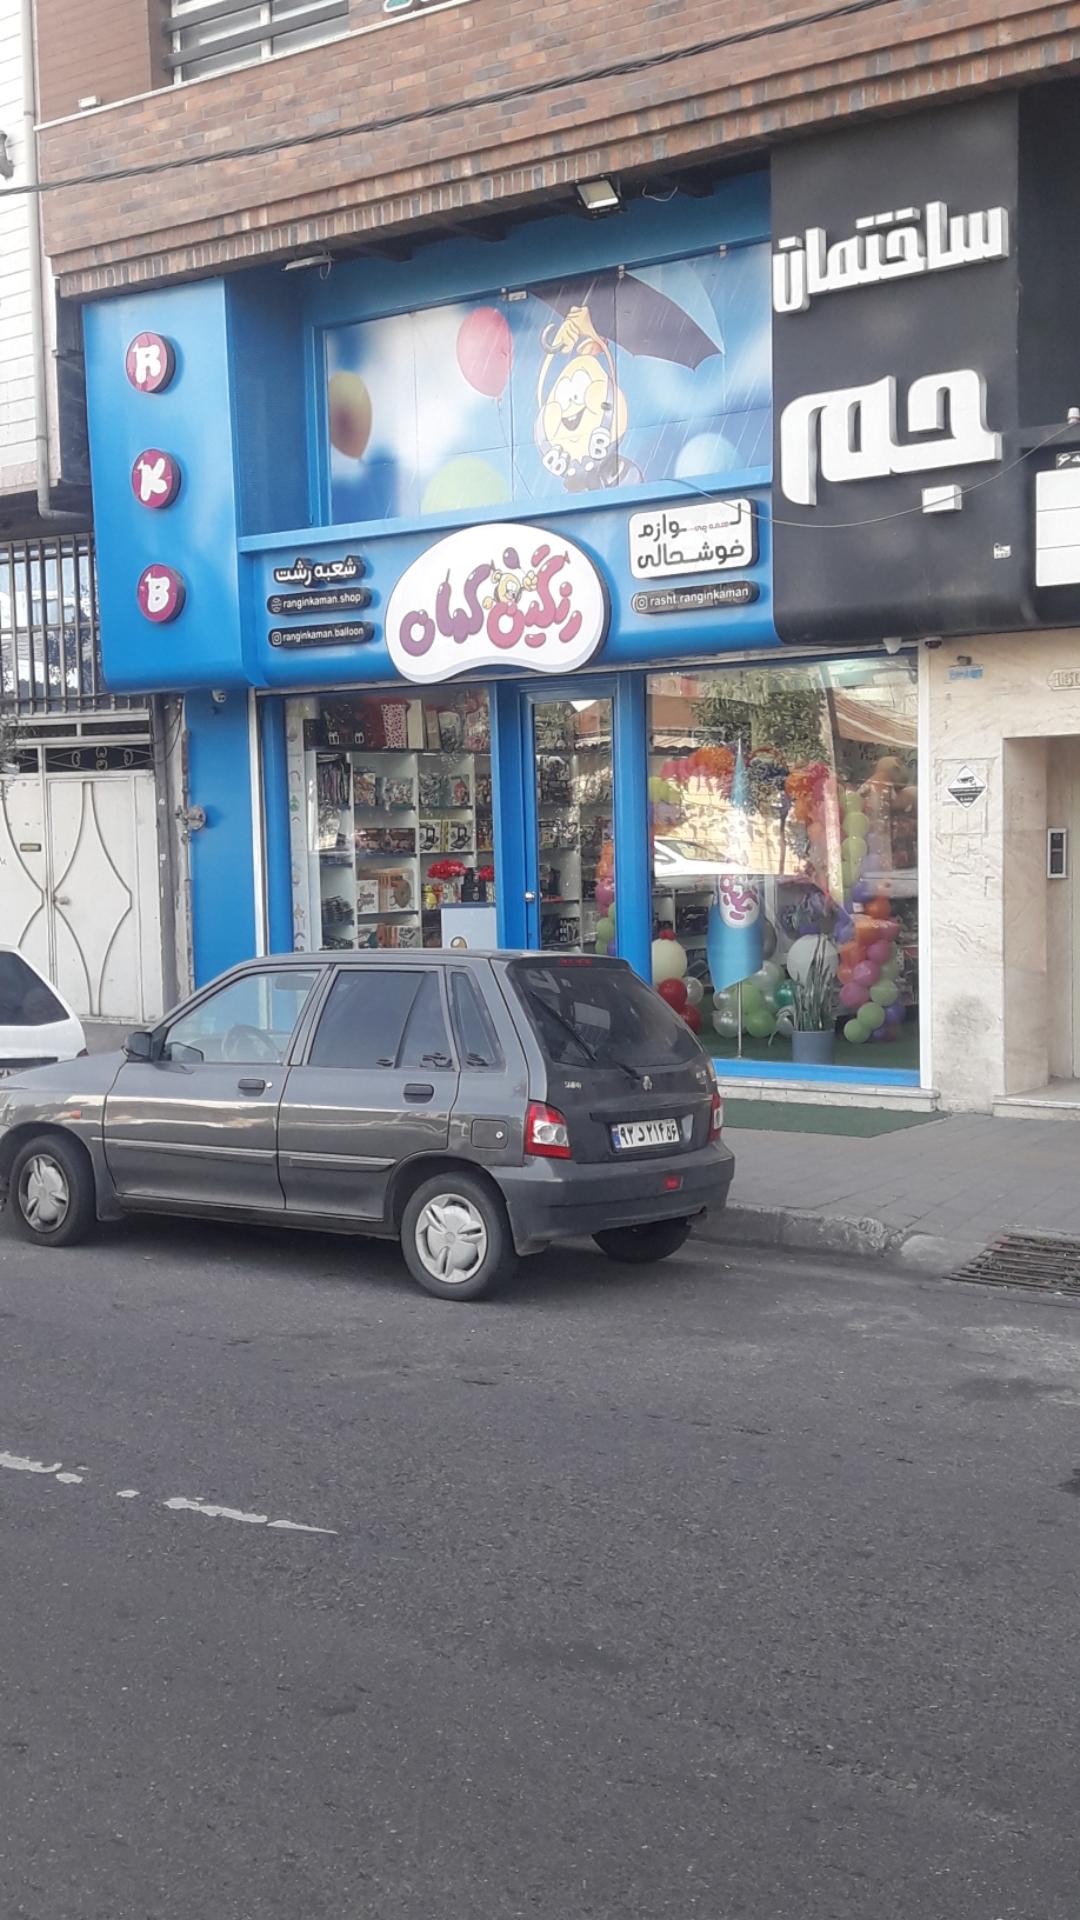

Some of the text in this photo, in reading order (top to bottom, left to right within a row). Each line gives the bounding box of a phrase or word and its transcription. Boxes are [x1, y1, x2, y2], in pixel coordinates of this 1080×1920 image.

[773, 200, 1009, 313] ساختمان
[132, 342, 162, 384] R
[780, 369, 1002, 513] جم
[137, 457, 168, 502] K
[275, 558, 357, 586] شعبه رشت
[637, 540, 745, 569] خوشحالی
[144, 572, 171, 613] B
[400, 544, 583, 657] رنگین کمان
[283, 627, 364, 643] ranginkaman.balloon
